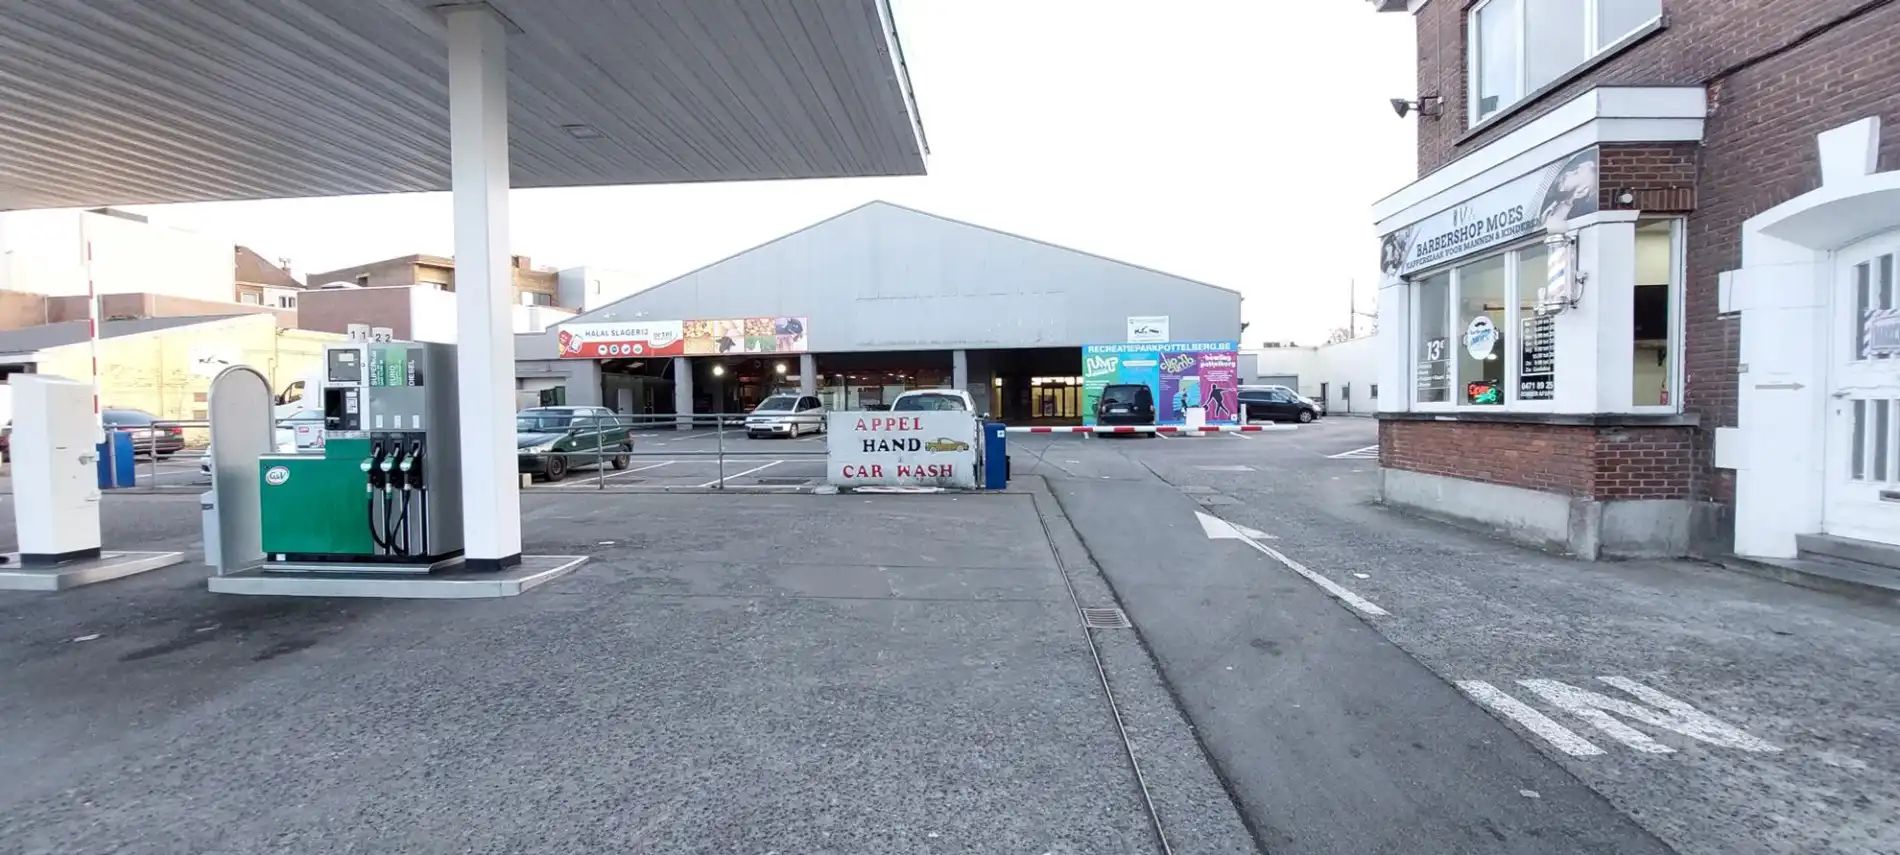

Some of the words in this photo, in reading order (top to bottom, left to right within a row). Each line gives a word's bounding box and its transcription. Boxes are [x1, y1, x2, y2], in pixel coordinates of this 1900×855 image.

[1416, 220, 1483, 257] BARBERSHOP
[1486, 204, 1524, 231] MOES
[1445, 243, 1463, 257] VOOR
[1463, 234, 1495, 252] MANNEN
[351, 330, 356, 339] 1
[361, 331, 366, 339] 1
[375, 333, 381, 342] 2
[384, 334, 391, 343] 2
[585, 328, 609, 337] HALAL
[611, 328, 648, 337] SLAGERIJ
[1087, 342, 1231, 353] RECREATIEPARKPOTTELBERG.BE
[855, 416, 923, 432] APPEL
[862, 437, 921, 452] HAND
[843, 464, 883, 478] CAR
[897, 464, 953, 478] WASH
[1454, 676, 1784, 756] IN
